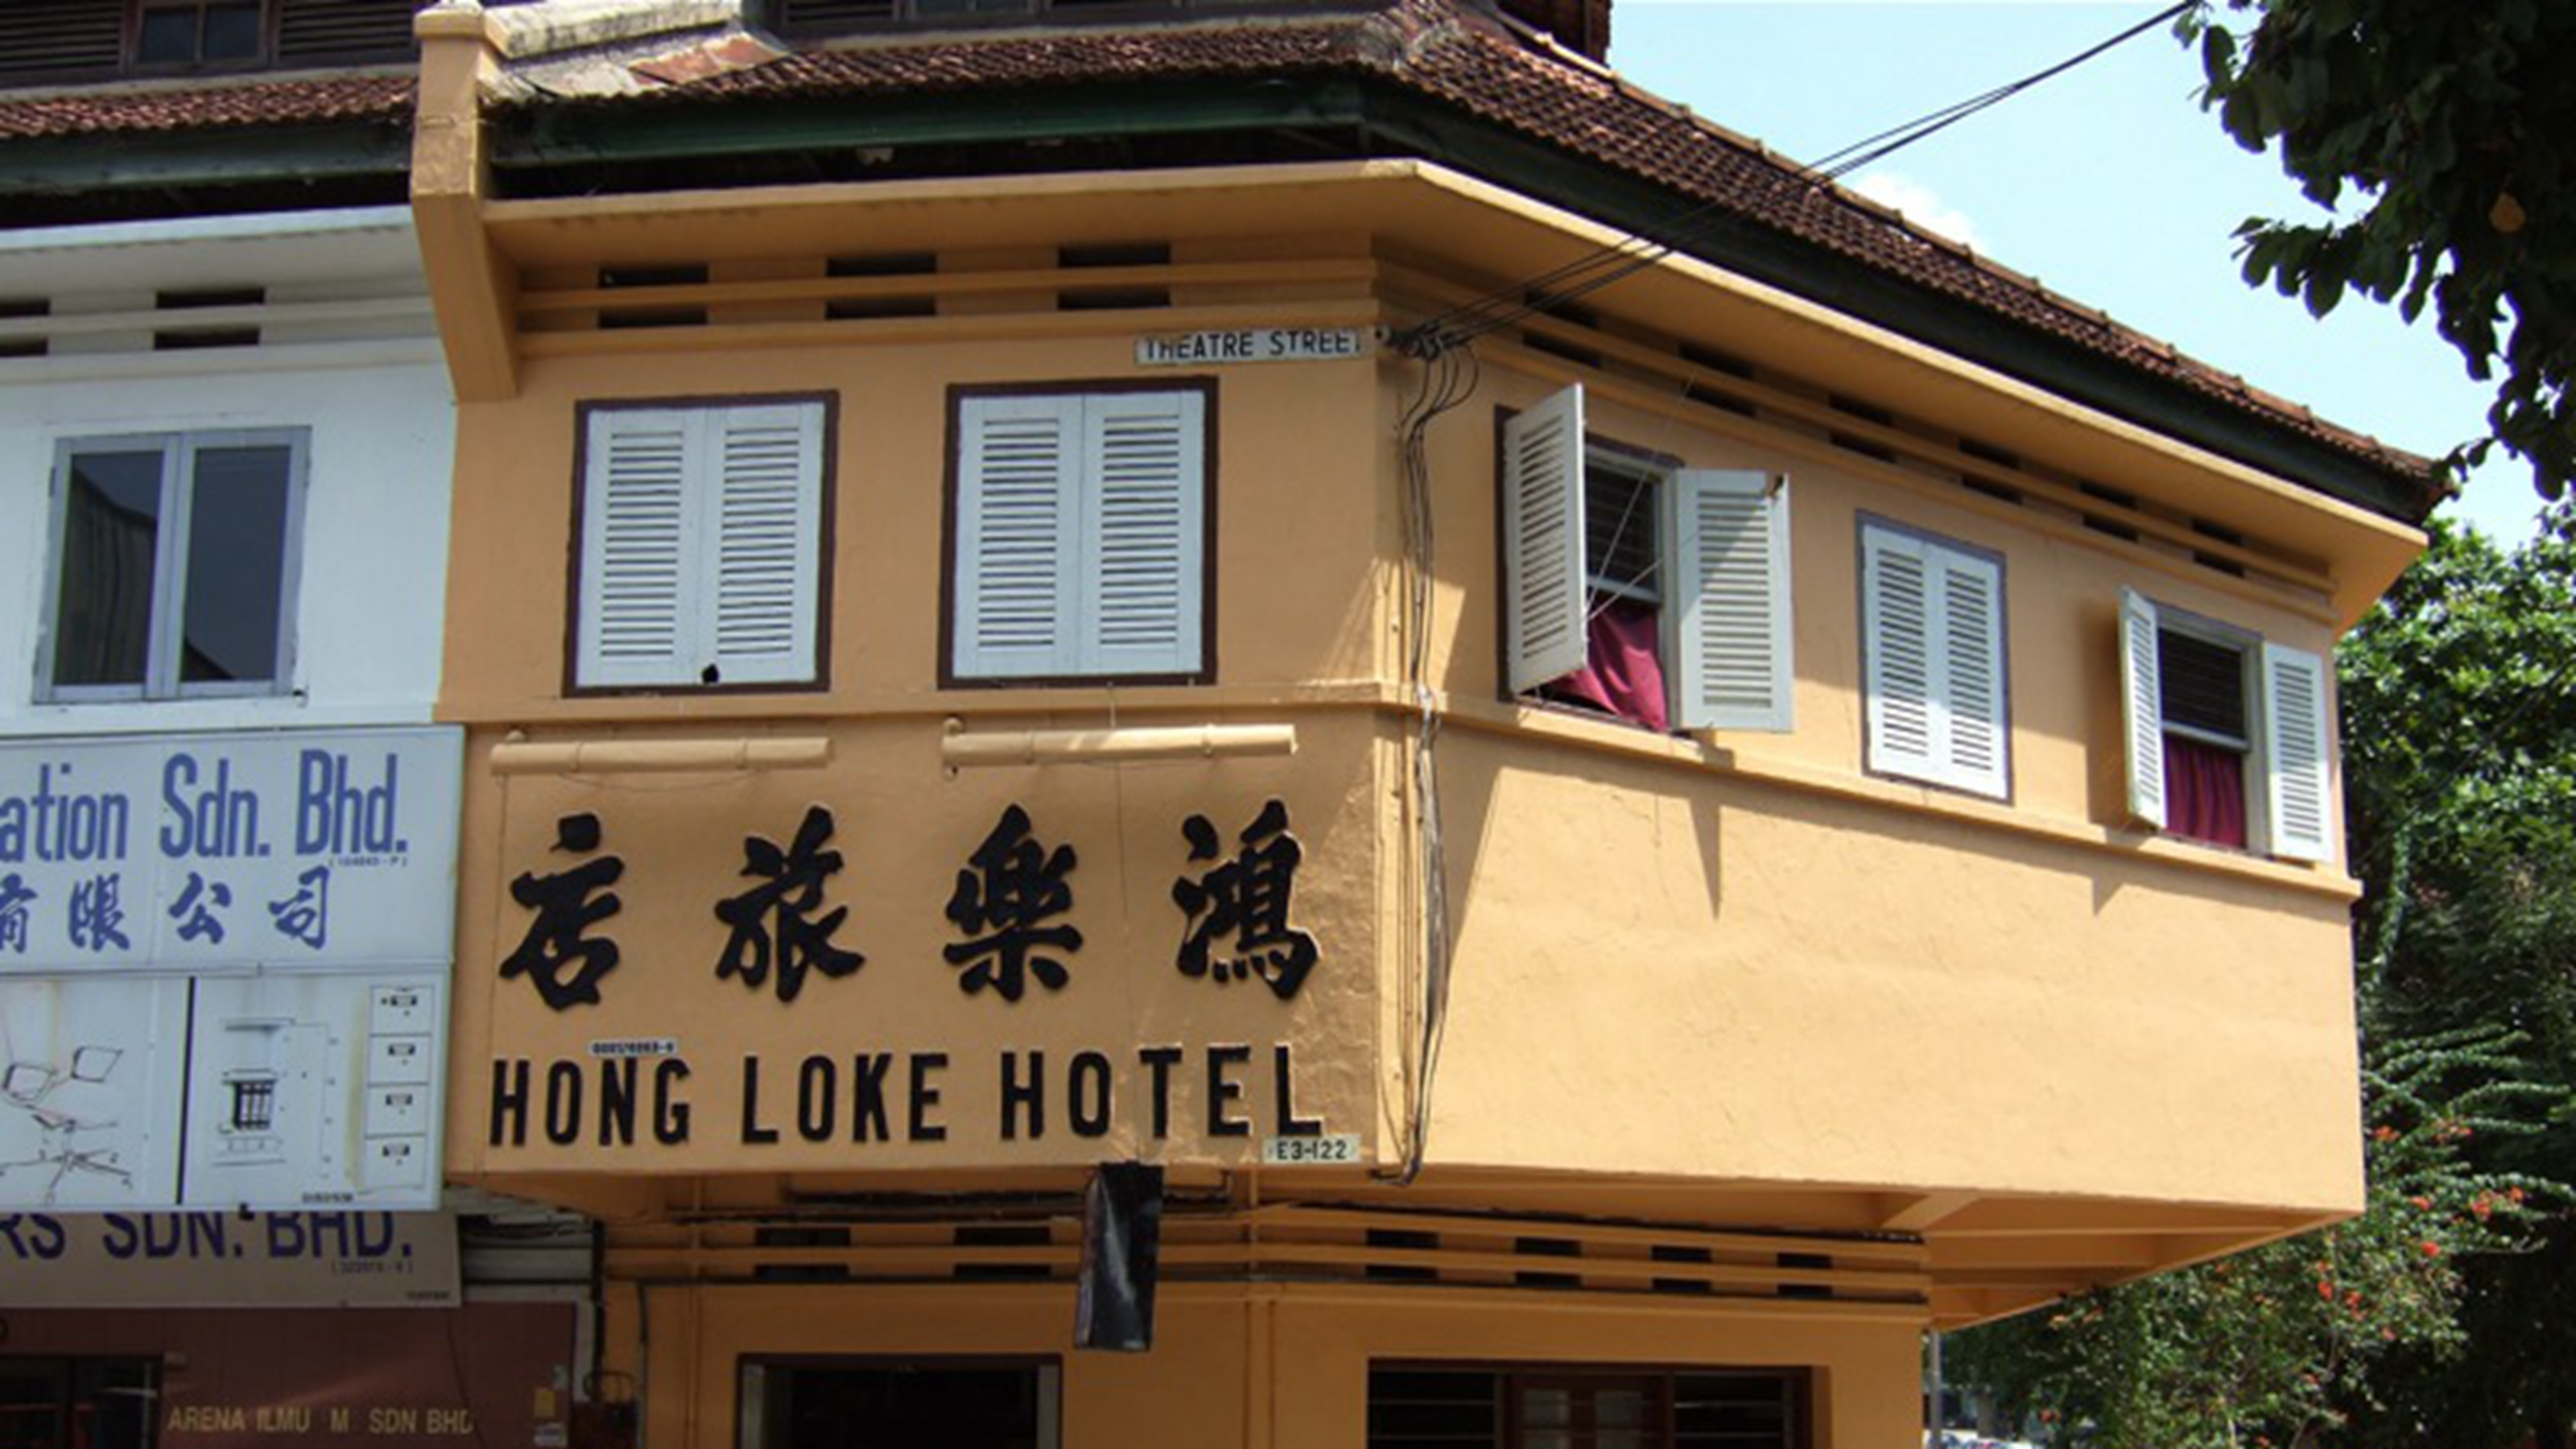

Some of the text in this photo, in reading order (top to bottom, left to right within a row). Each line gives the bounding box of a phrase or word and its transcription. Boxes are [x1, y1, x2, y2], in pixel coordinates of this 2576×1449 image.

[1143, 332, 1254, 360] THEATRE
[0, 749, 407, 863] ation Sdn. Bhd.
[489, 1046, 1324, 1147] HONG LOKE HOTEL
[1277, 1139, 1348, 1161] E3-122
[102, 1212, 243, 1260] SDN.
[266, 1212, 413, 1258] BHD.
[167, 1406, 246, 1433] ARENA
[256, 1406, 311, 1434] ILMU
[368, 1406, 418, 1435] SDN
